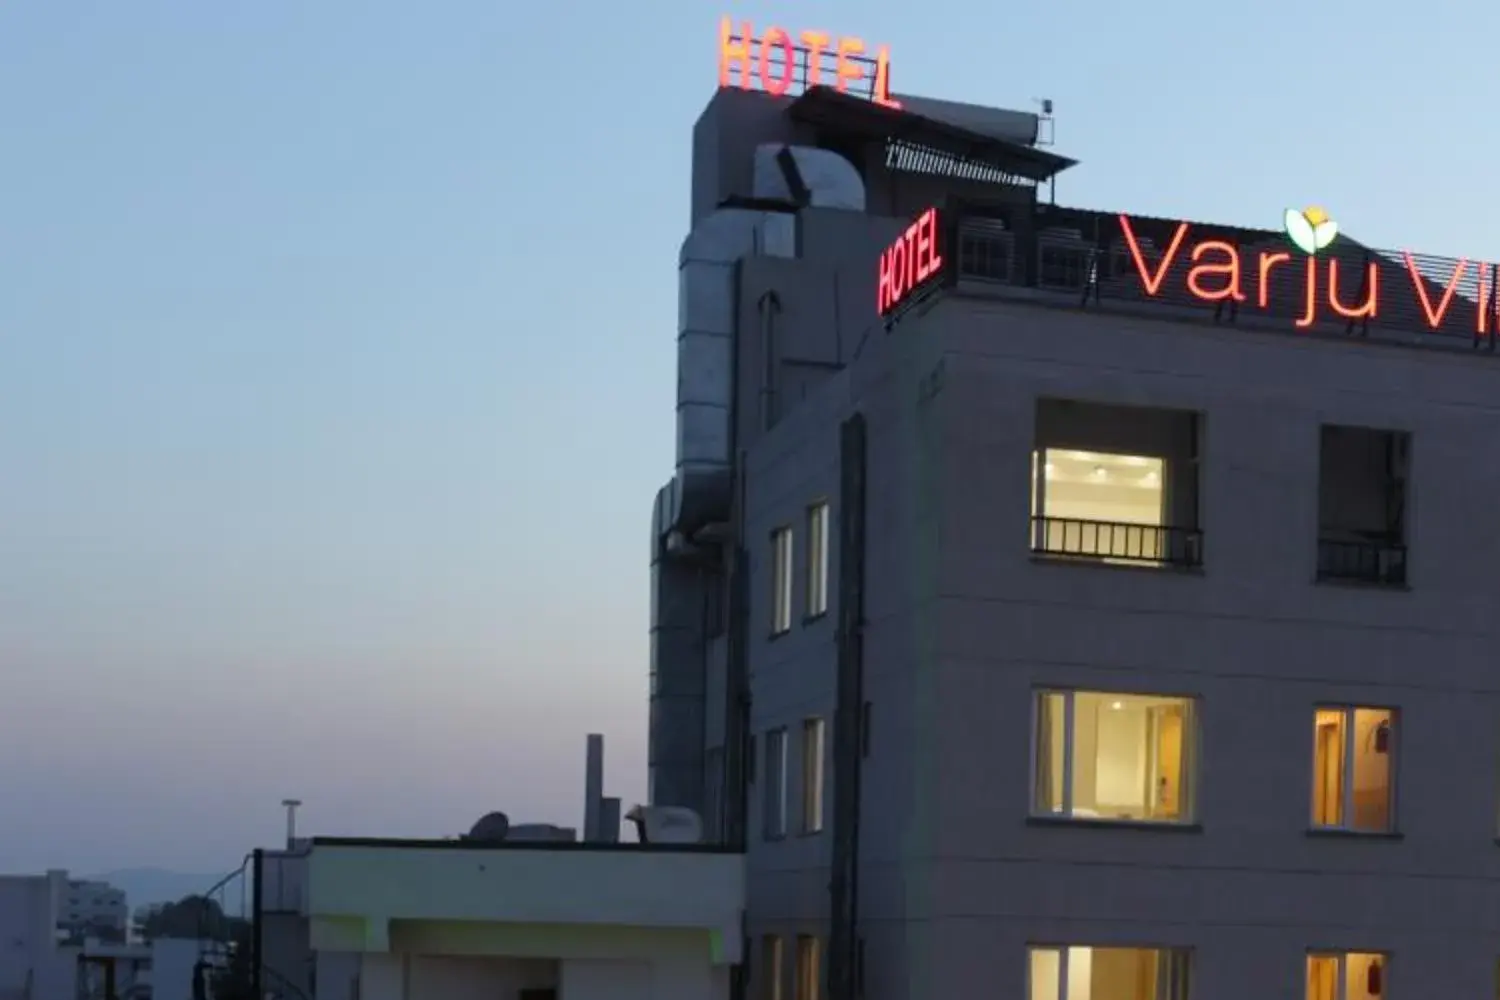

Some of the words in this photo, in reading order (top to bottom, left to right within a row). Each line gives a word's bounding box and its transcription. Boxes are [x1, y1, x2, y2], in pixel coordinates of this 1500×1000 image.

[718, 15, 904, 109] HOTEL
[877, 206, 943, 316] HOTEL
[1119, 209, 1381, 328] Varju
